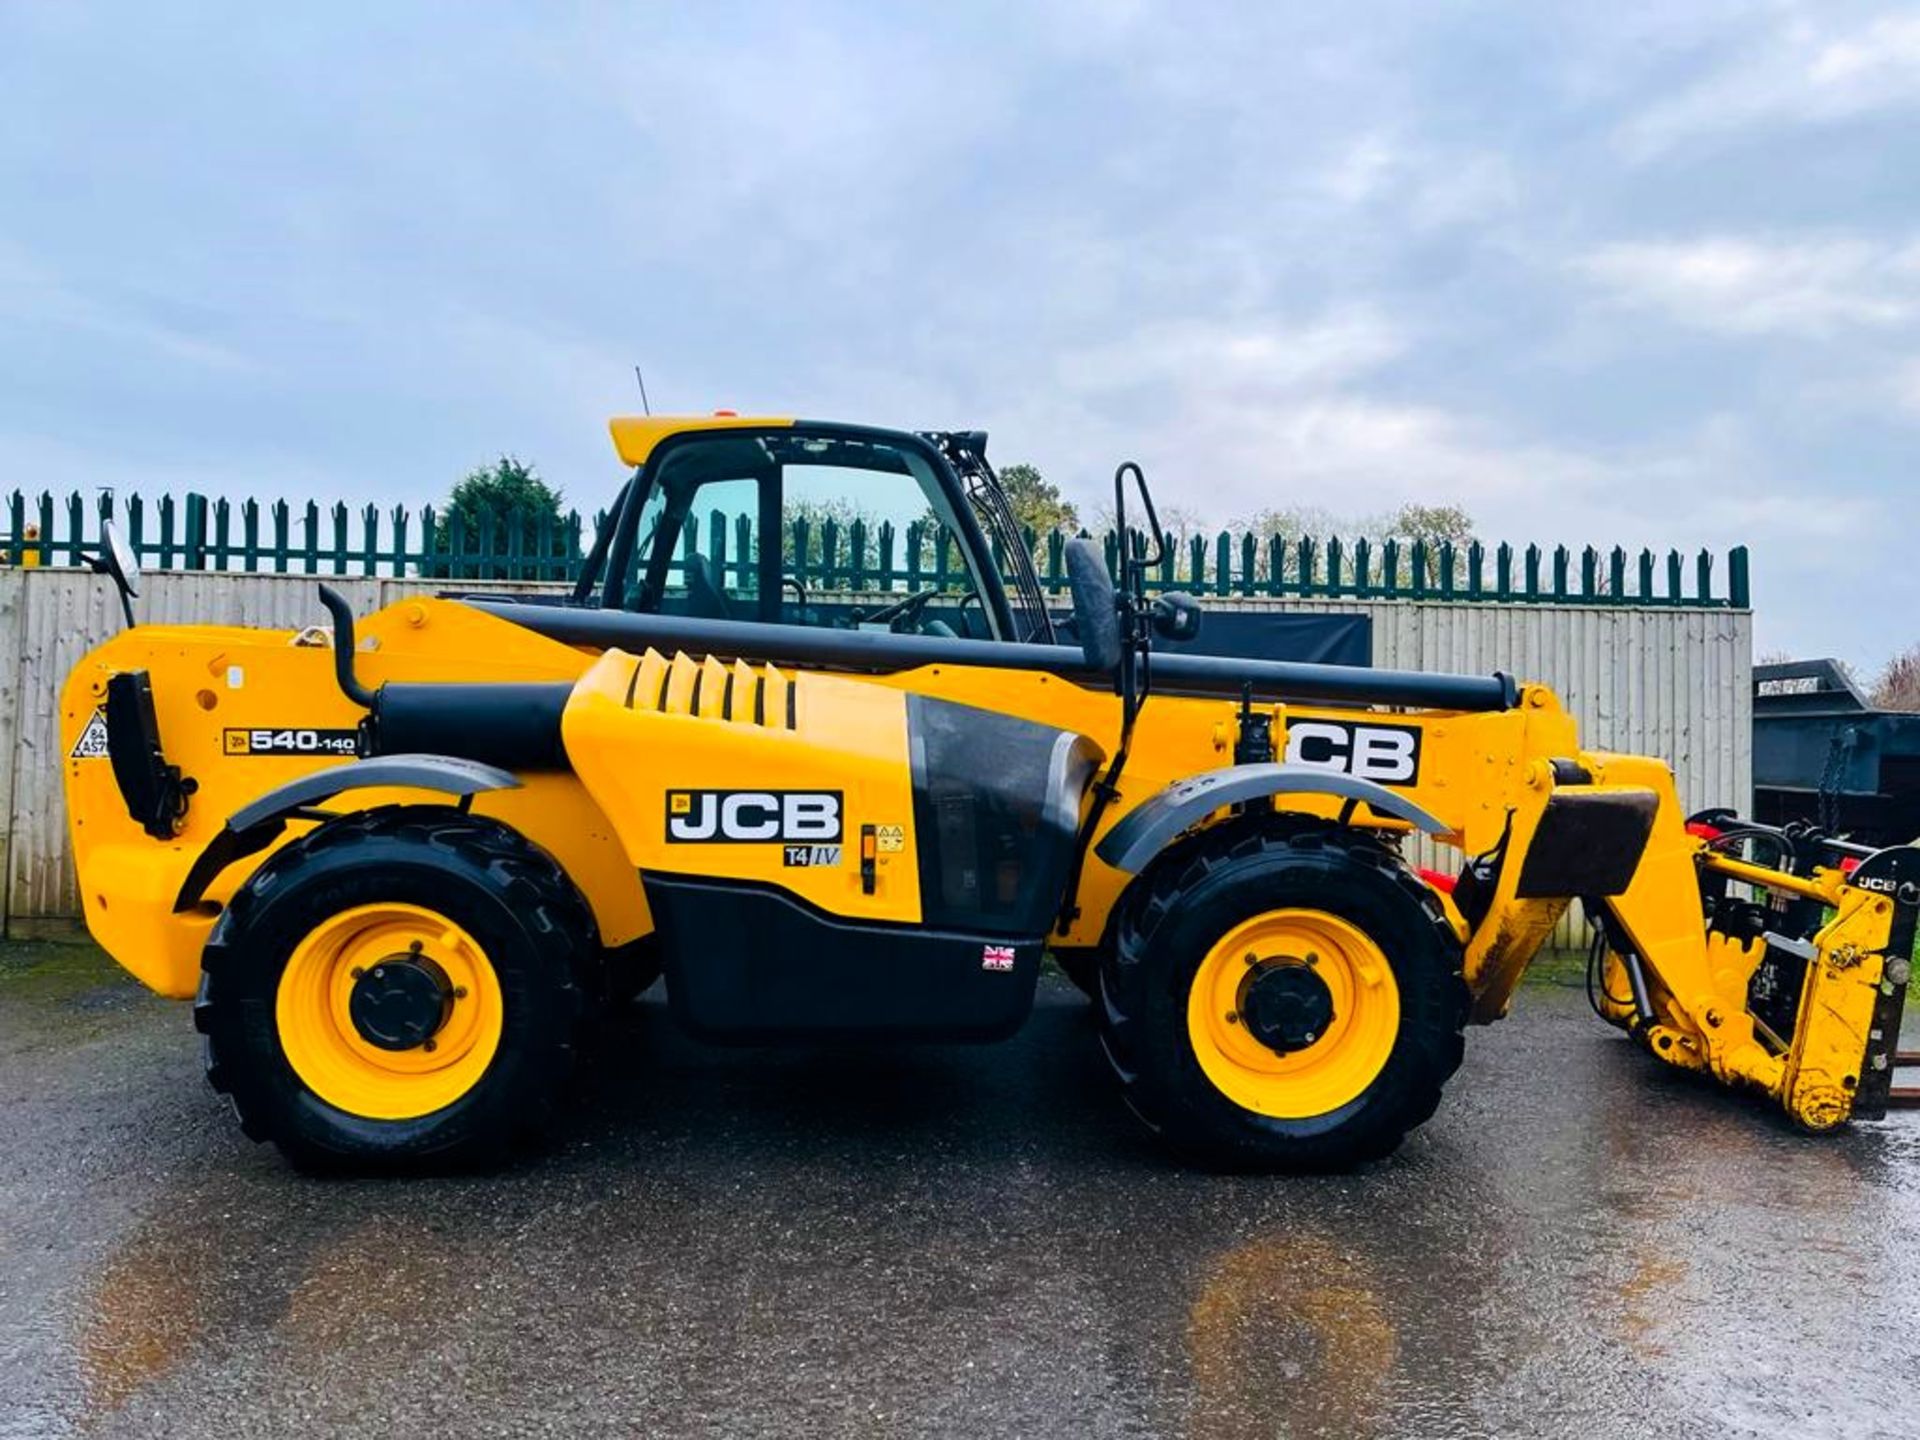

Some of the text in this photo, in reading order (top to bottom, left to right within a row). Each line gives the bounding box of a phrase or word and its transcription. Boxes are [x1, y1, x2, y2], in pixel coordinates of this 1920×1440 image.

[1286, 723, 1415, 781] CB
[671, 793, 841, 840] JCB
[1858, 876, 1897, 891] JCB
